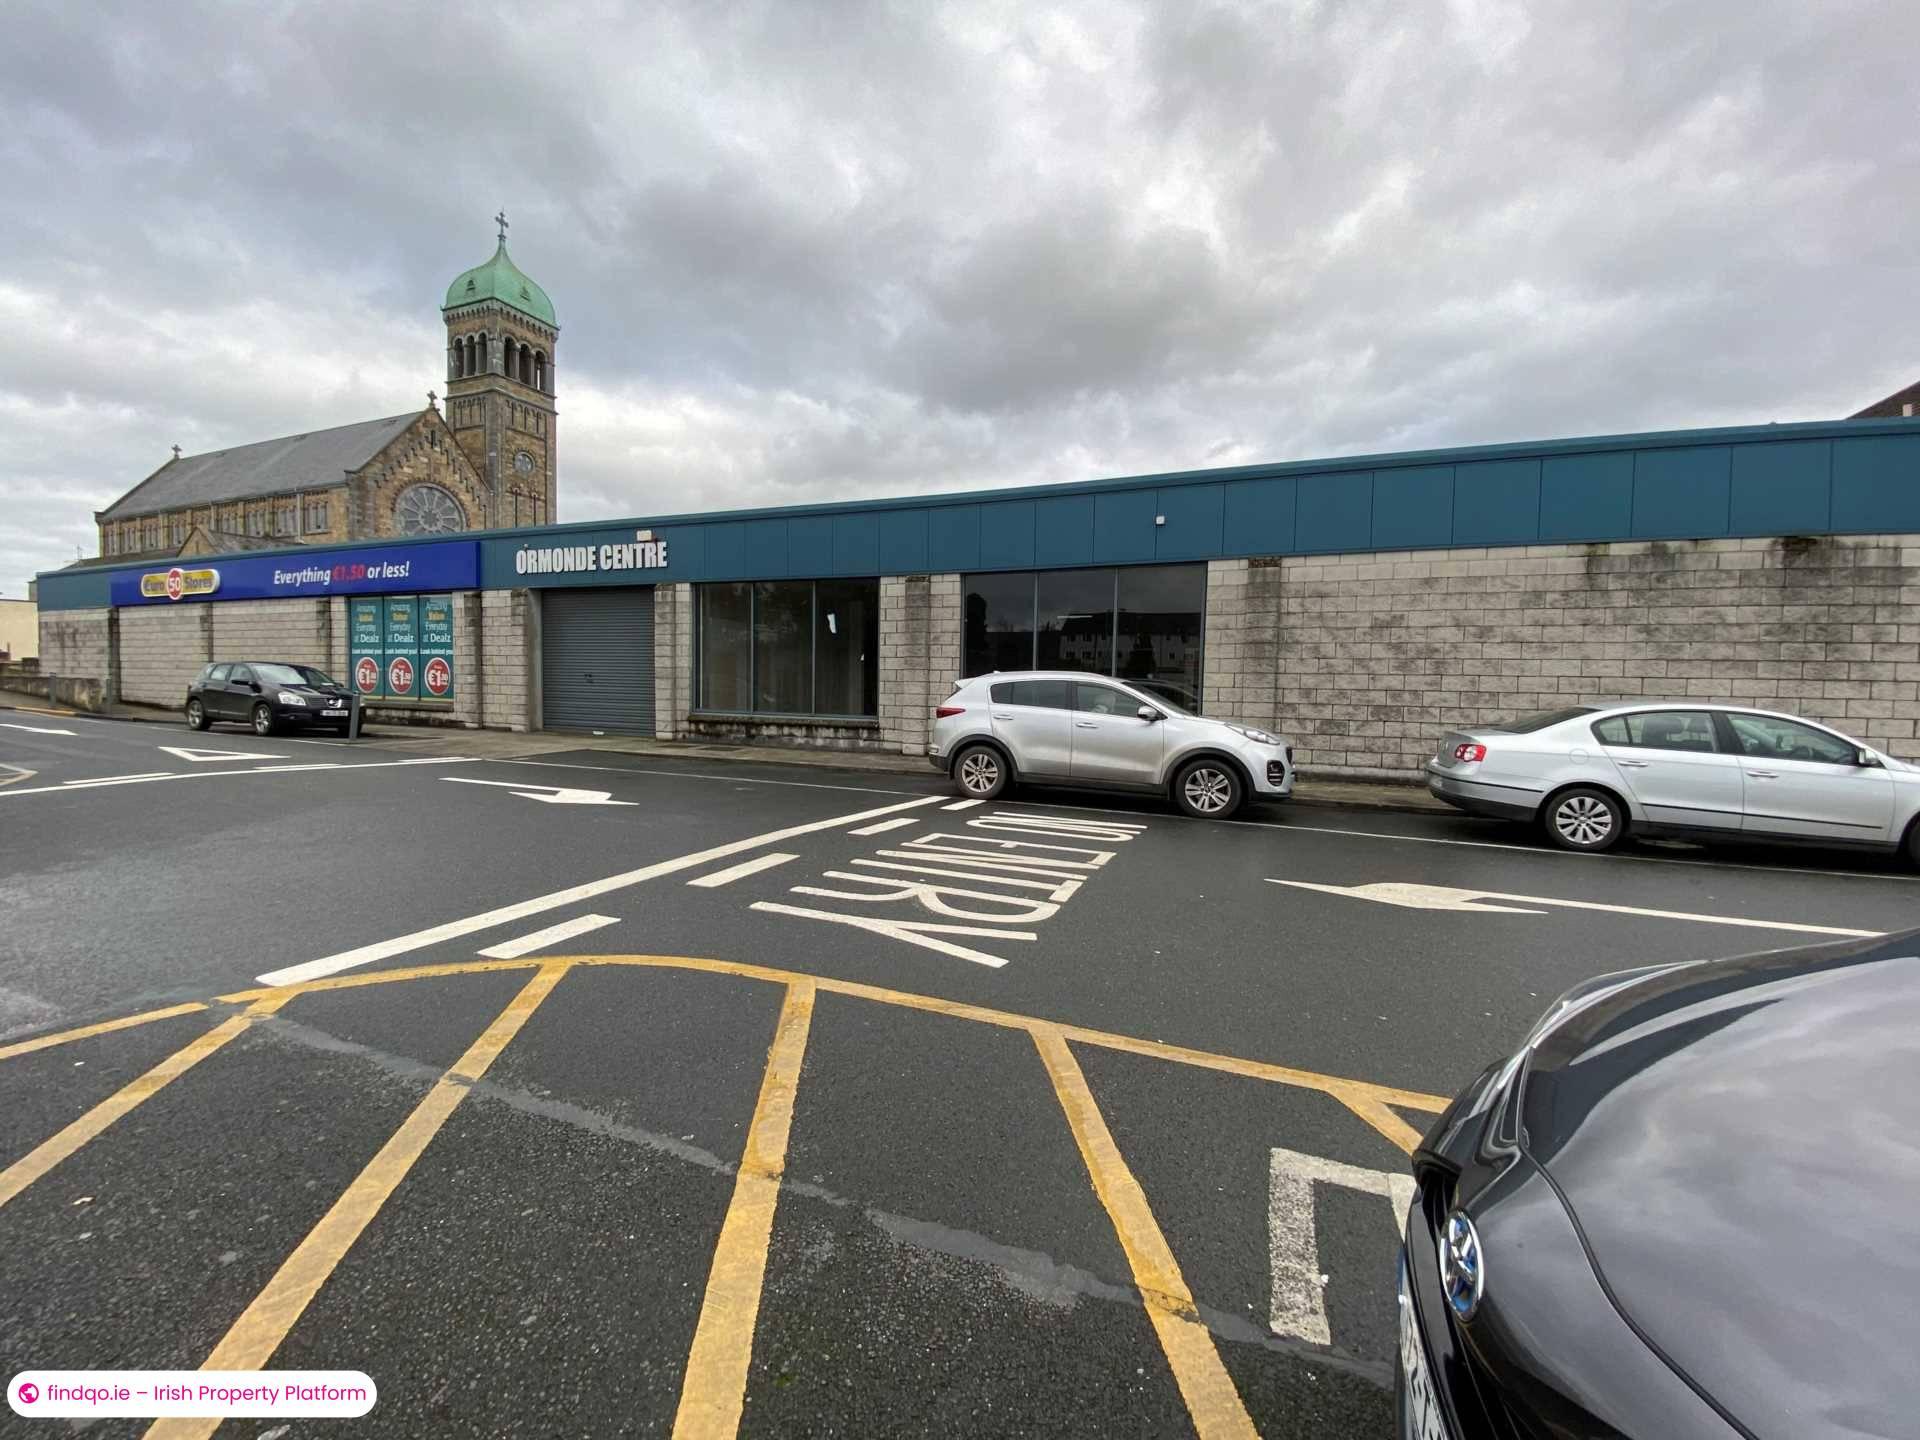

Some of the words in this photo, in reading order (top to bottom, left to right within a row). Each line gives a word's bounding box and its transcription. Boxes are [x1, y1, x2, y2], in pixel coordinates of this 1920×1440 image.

[516, 546, 597, 575] ORMONDE
[599, 541, 668, 570] CENTRE
[273, 566, 331, 587] Everything
[332, 564, 365, 581] €1.50
[367, 565, 381, 579] or
[382, 561, 410, 578] less!
[169, 577, 181, 592] 50
[360, 633, 380, 643] Dealz
[394, 633, 414, 643] Dealz
[430, 633, 451, 643] Dealz
[966, 811, 1148, 842] NO
[749, 832, 1118, 969] ENTRY
